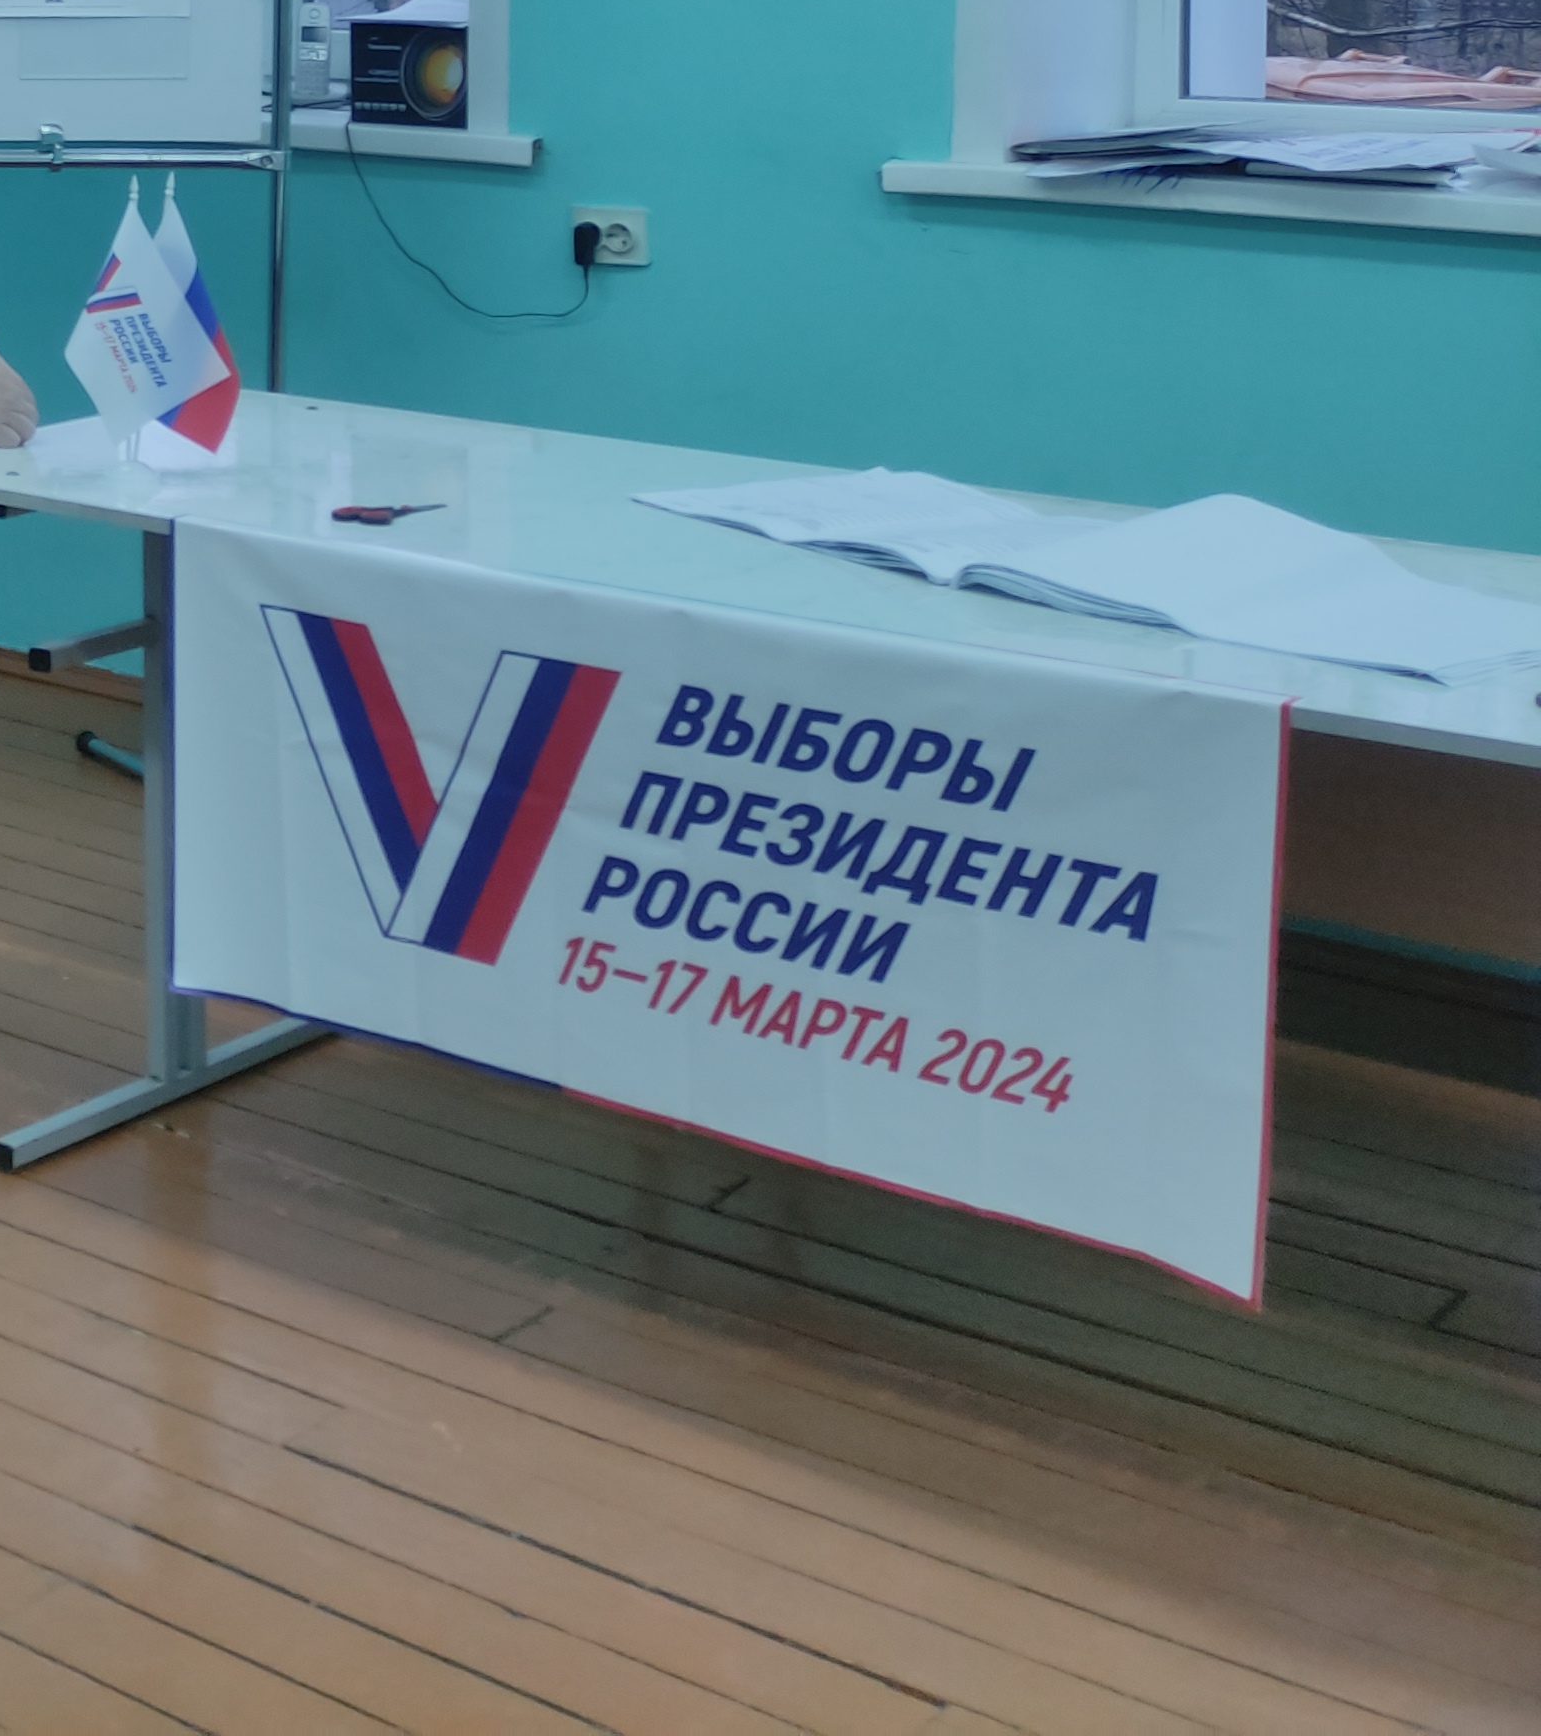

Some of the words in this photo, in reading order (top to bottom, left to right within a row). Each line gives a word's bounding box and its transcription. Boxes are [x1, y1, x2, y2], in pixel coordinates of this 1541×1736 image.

[108, 319, 138, 363] РОССИИ
[125, 316, 167, 387] ПРЕЗИДЕНТА
[138, 313, 172, 362] ВЫБОРЫ
[655, 683, 1037, 813] ВЫБОРЫ
[580, 854, 911, 984] РОССИИ
[619, 770, 1159, 943] ПРЕЗИДЕНТА
[709, 975, 908, 1073] МАРТА
[917, 1027, 1075, 1115] 2024
